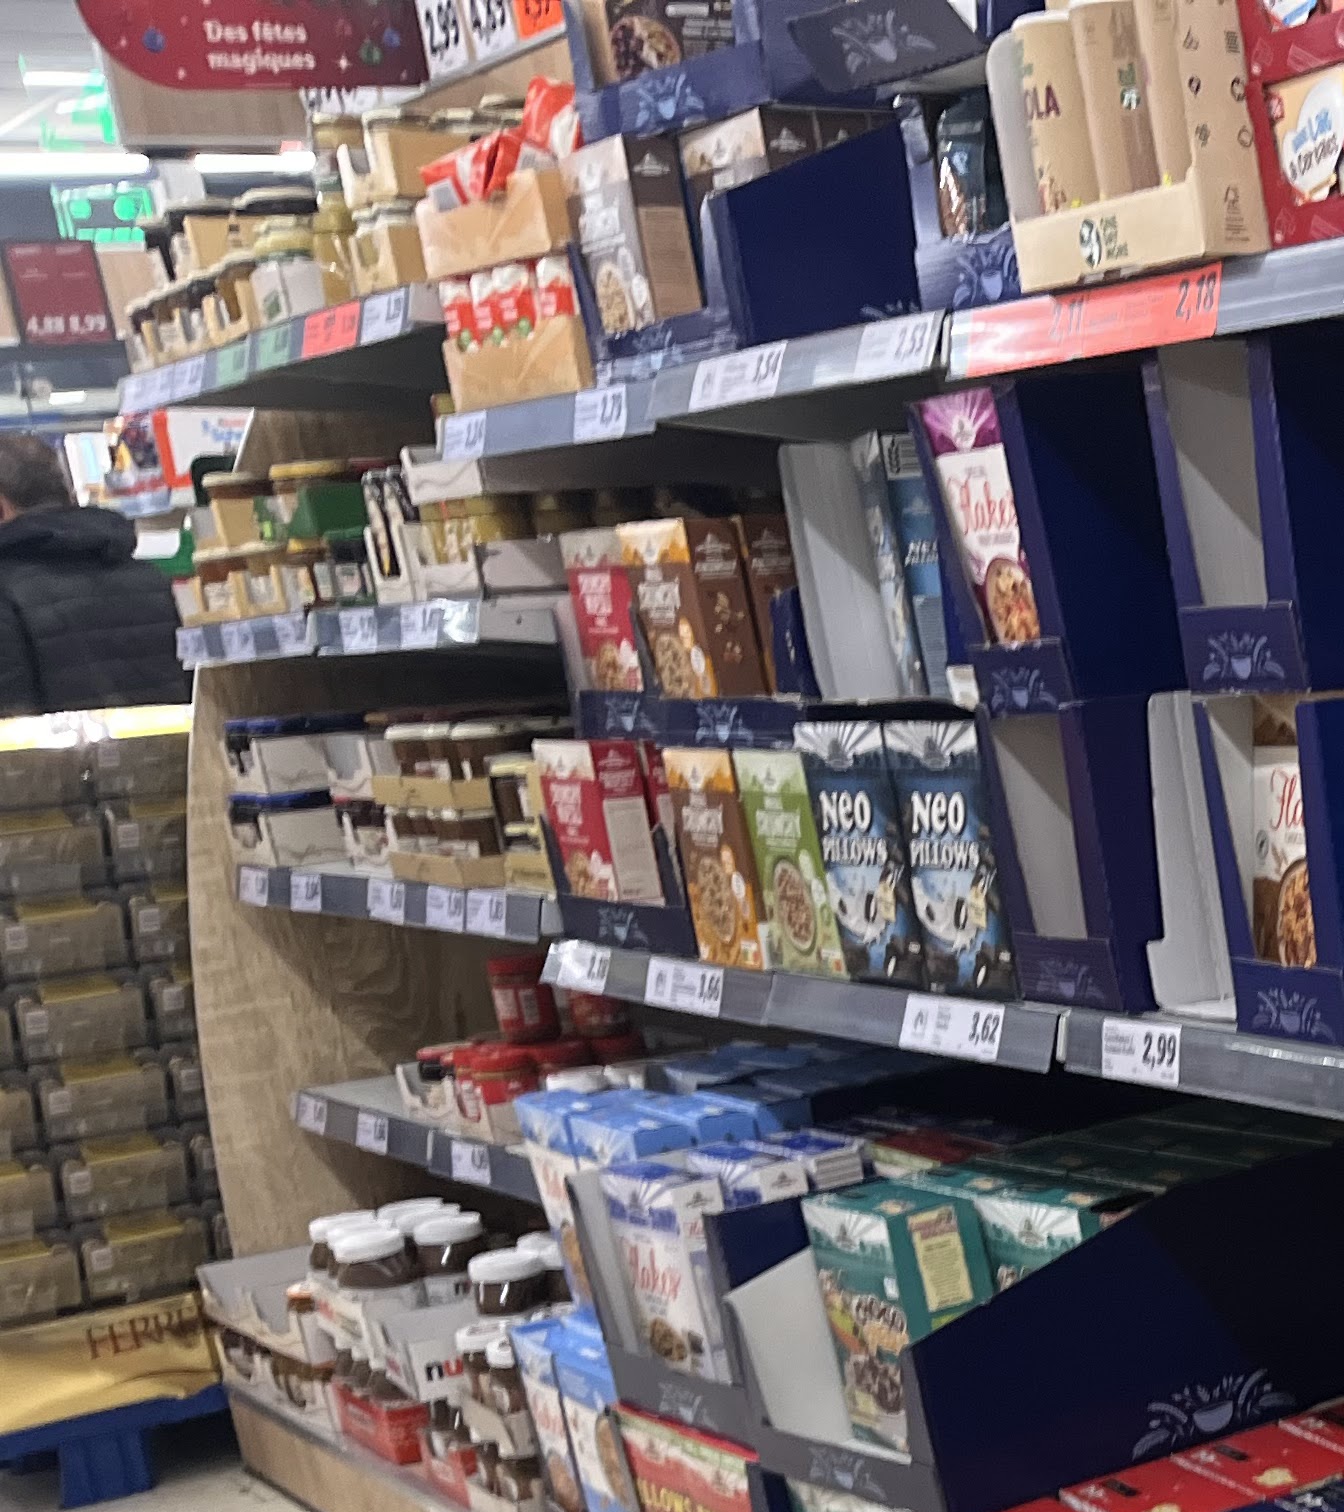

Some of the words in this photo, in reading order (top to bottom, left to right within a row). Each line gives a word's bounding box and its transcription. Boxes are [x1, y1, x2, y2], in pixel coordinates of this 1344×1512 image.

[204, 20, 249, 43] Des
[206, 48, 315, 75] magiques
[969, 1012, 1001, 1044] 3,62
[1142, 1034, 1177, 1069] 2,99
